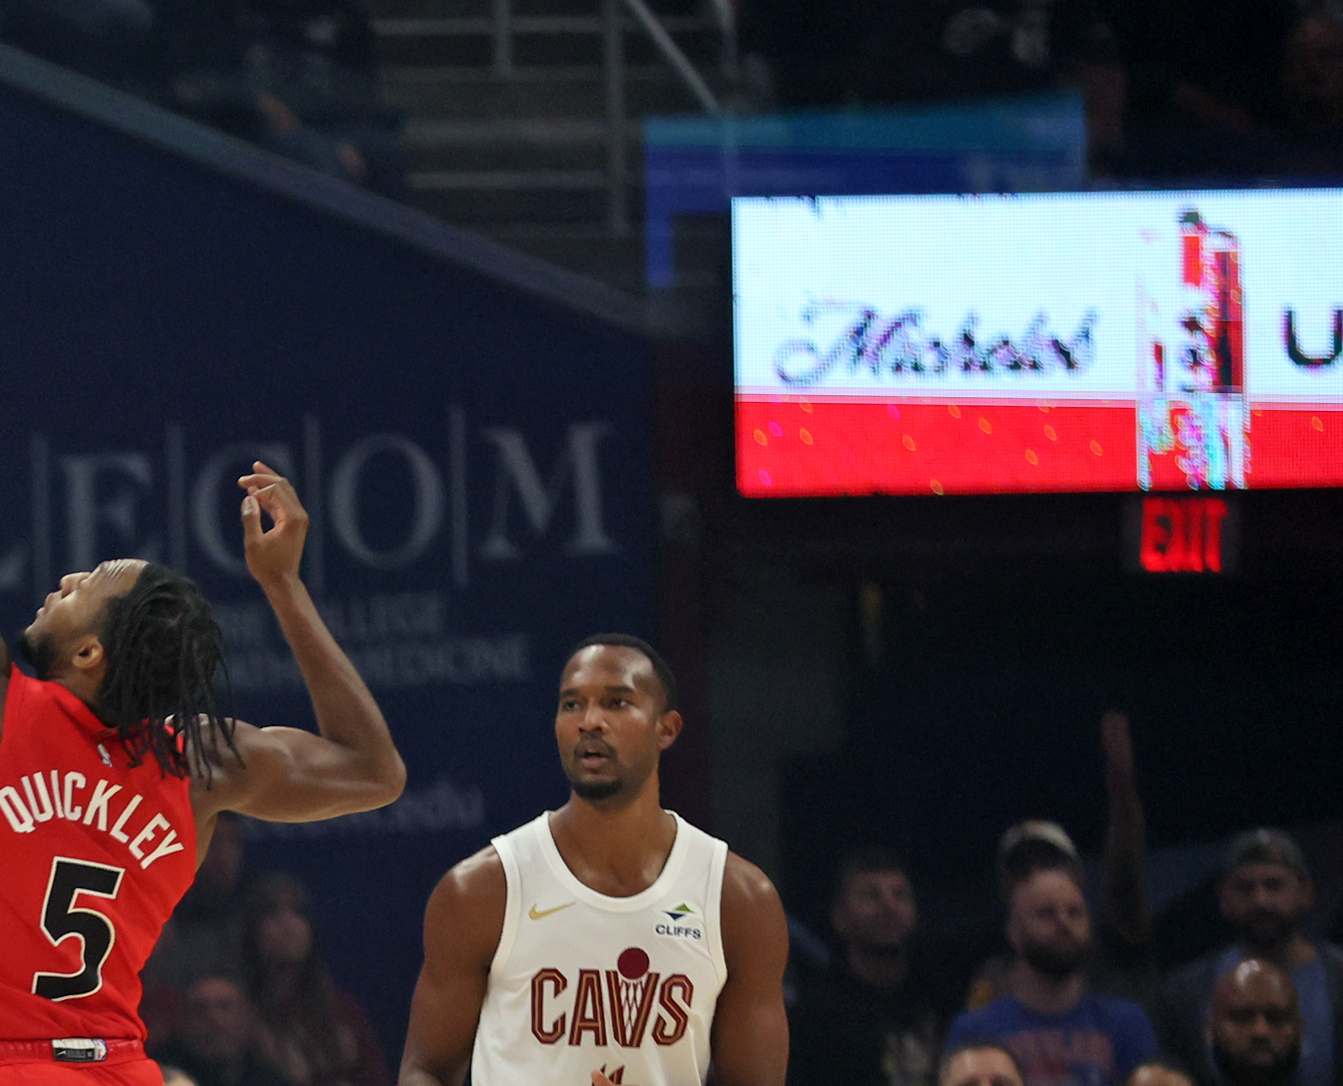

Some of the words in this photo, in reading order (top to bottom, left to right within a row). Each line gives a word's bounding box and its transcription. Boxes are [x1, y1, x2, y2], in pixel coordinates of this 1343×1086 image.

[1141, 497, 1227, 573] EXIT
[32, 855, 126, 1002] 5
[655, 924, 701, 941] CLIFFS
[531, 966, 694, 1049] CAVS
